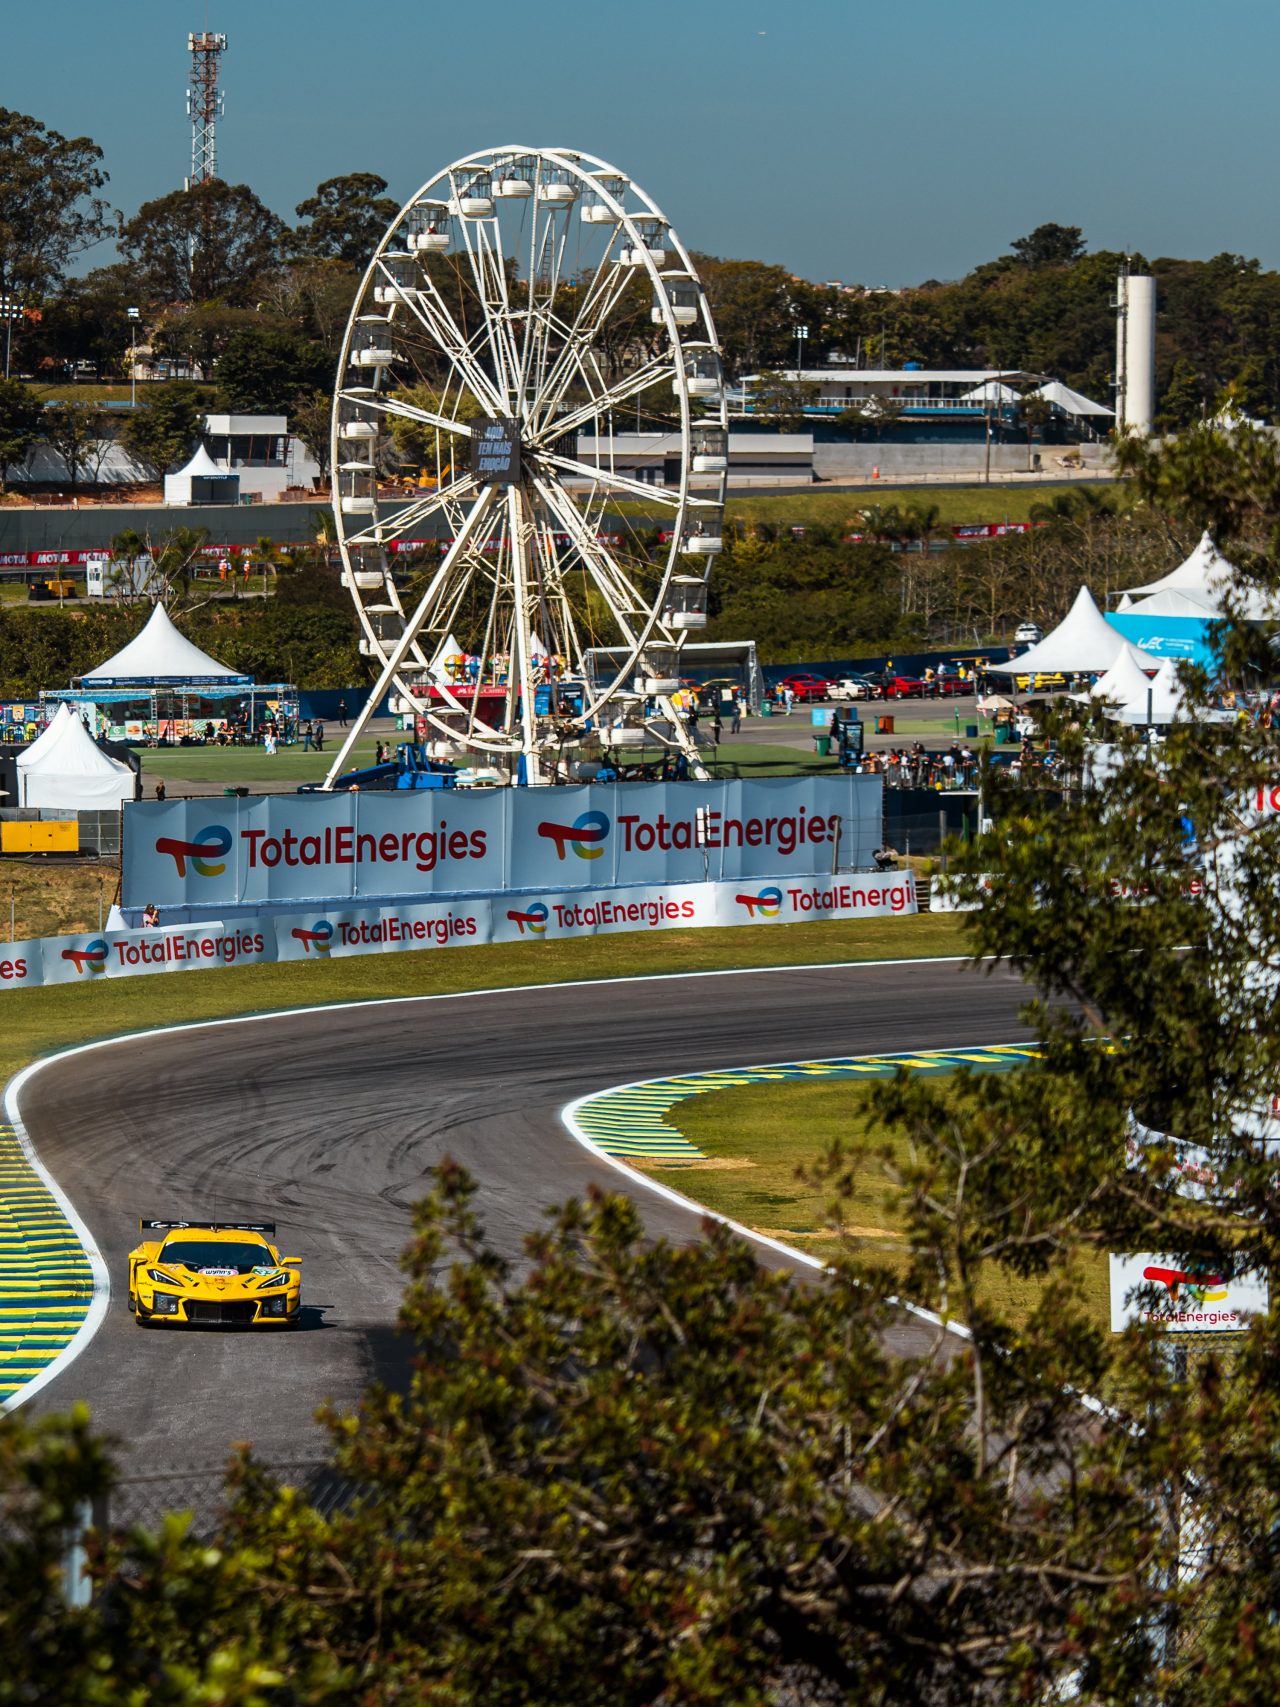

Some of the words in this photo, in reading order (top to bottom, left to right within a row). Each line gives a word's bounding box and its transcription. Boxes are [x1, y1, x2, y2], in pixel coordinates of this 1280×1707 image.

[37, 552, 69, 564] MOTUL
[241, 820, 487, 872] TotalEnergies
[618, 806, 842, 855] TotalEnergies
[113, 930, 265, 964] TotalEnergies
[338, 912, 477, 946] TotalEnergies
[553, 896, 696, 928] TotalEnergies
